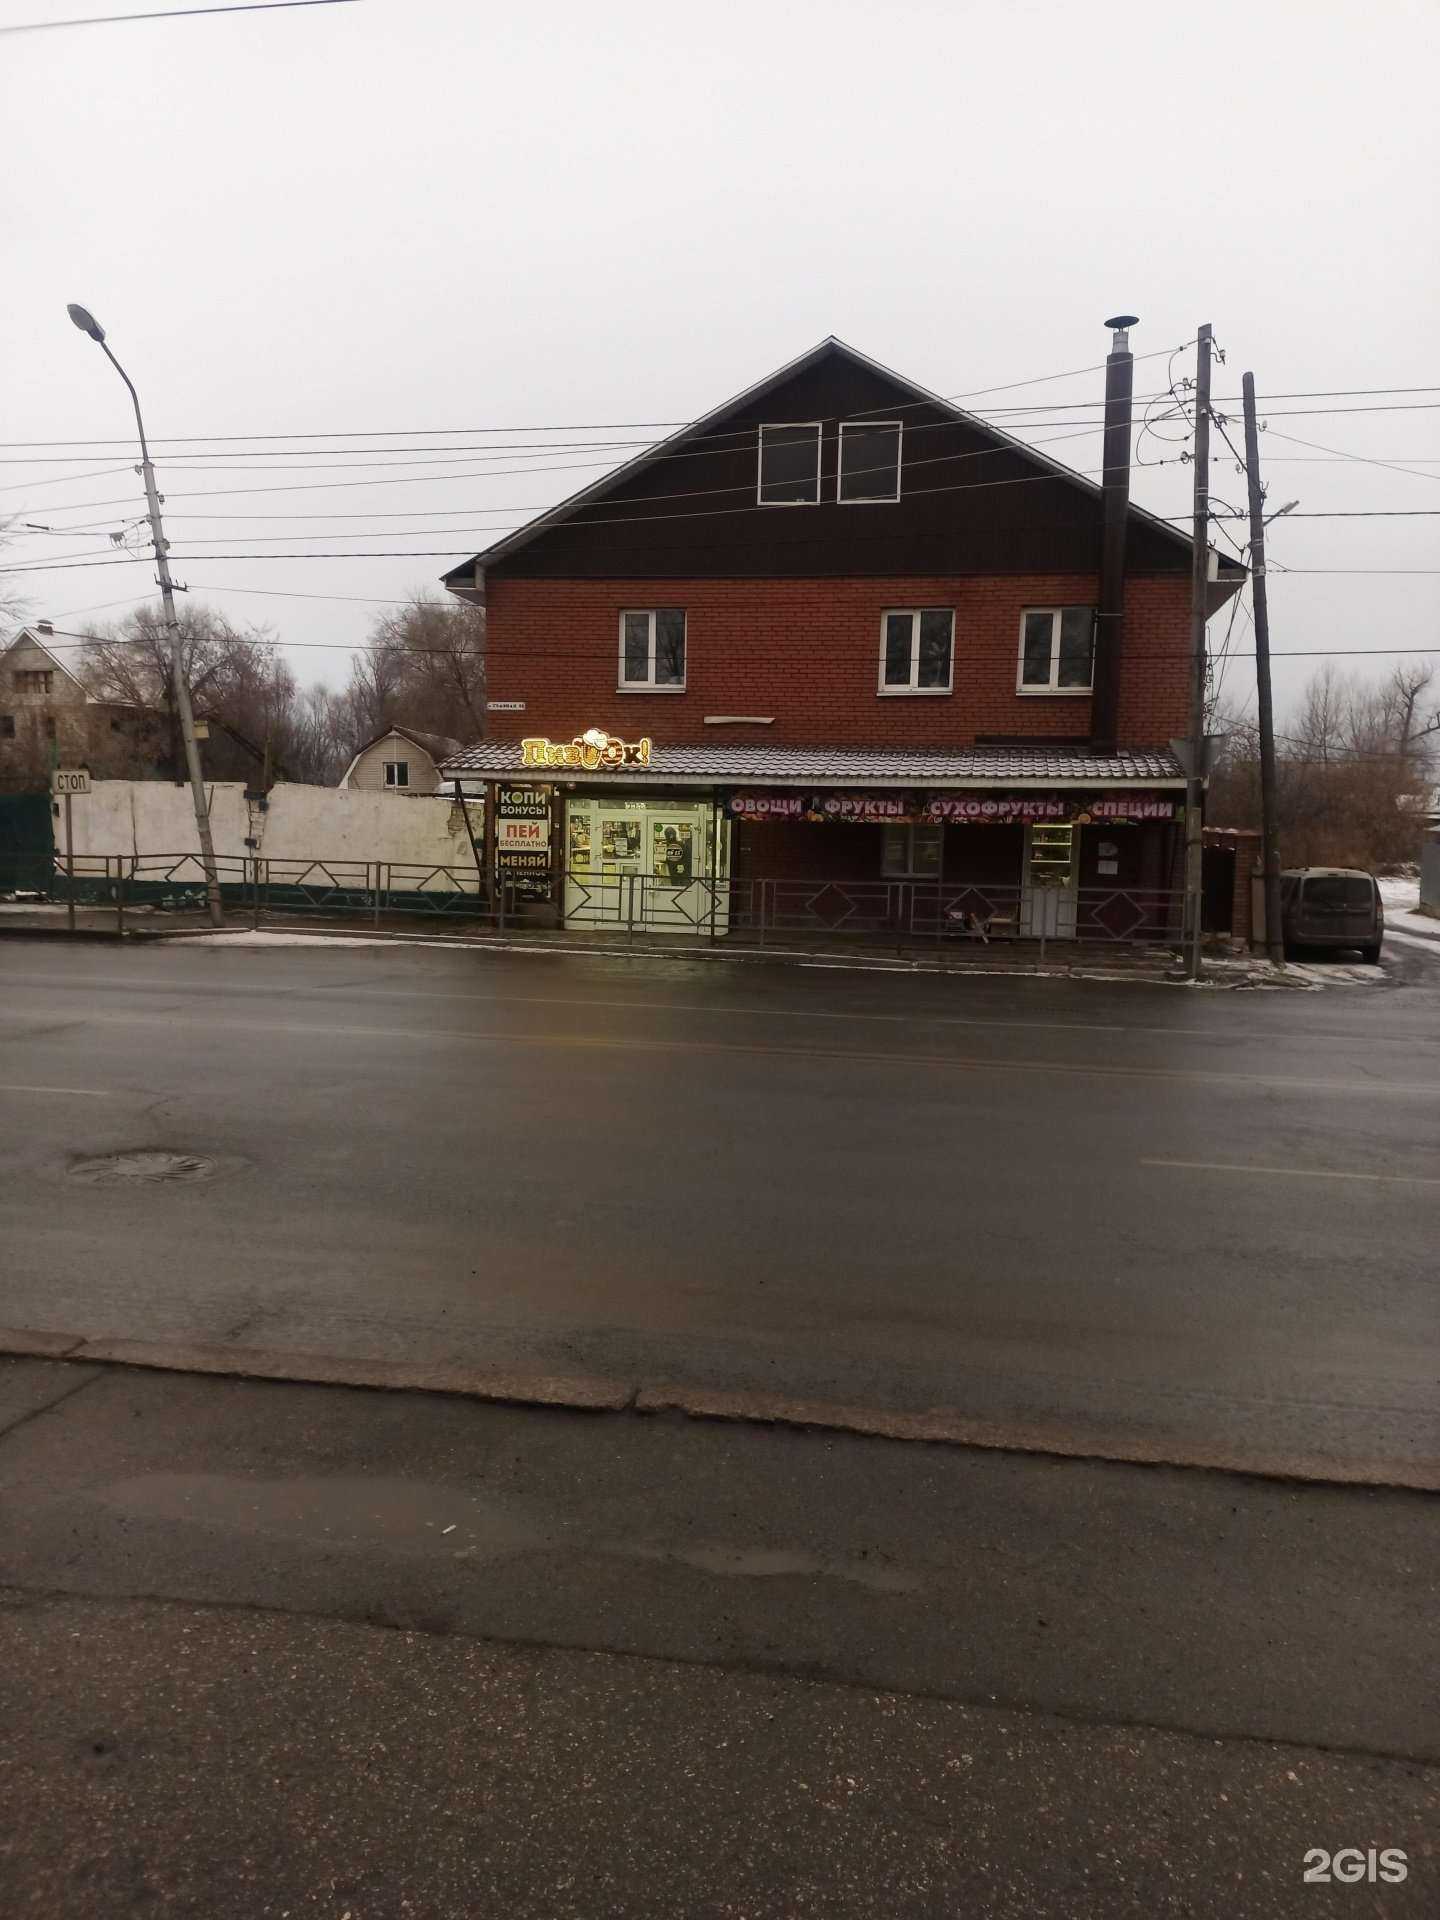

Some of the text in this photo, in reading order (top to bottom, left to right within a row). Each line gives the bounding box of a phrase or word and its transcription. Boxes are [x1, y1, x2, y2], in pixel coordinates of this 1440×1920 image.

[57, 774, 87, 790] СТОП
[501, 791, 546, 804] КОПИ
[500, 805, 546, 815] БОНУСЫ
[731, 799, 1173, 818] ОВОЩИ ФРУКТЫ СУХОФРУКТЫ СПЕЦИИ
[506, 821, 540, 838] ПЕЙ
[500, 840, 547, 848] БЕСПЛАТНО
[500, 854, 546, 867] МЕНЯЙ
